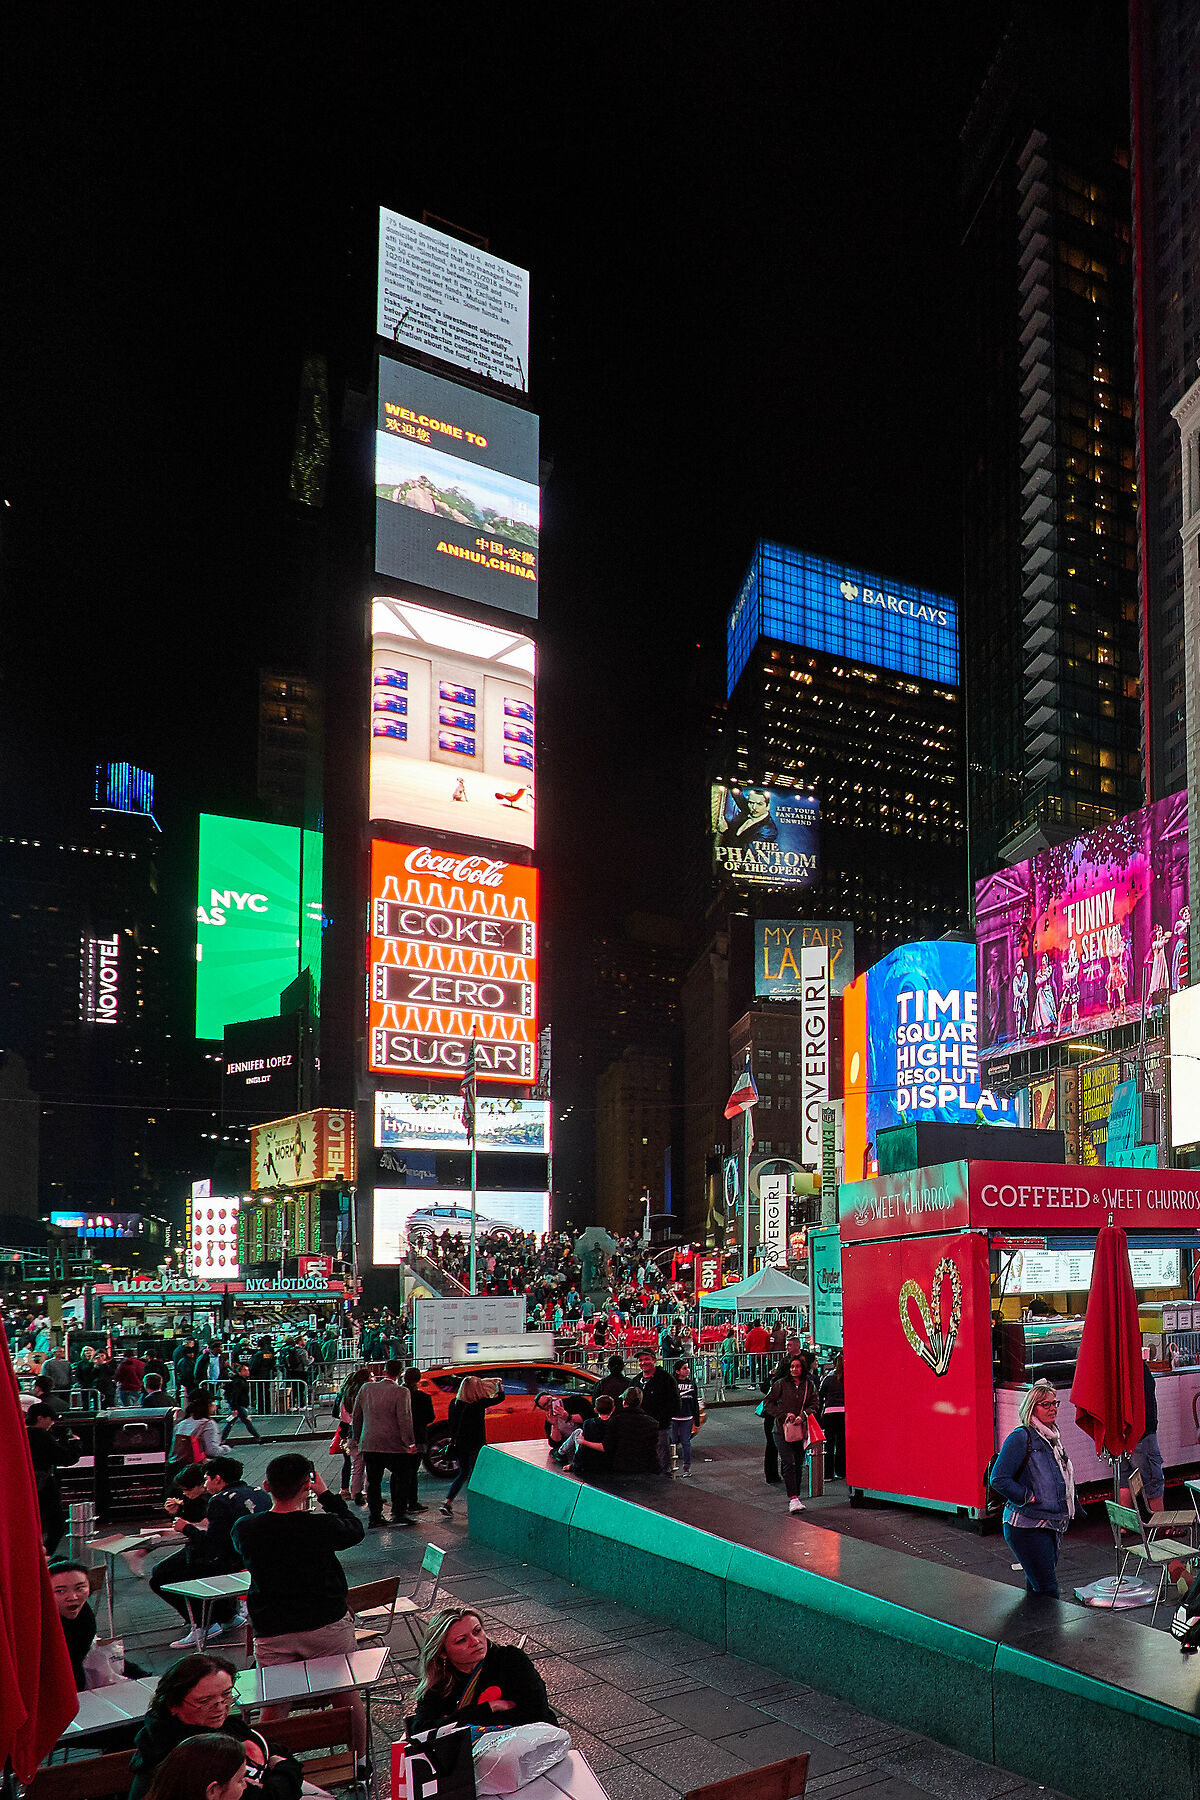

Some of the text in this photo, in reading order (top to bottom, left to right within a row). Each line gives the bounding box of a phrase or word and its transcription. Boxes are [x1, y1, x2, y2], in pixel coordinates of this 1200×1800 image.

[385, 402, 488, 448] WELCOME TO
[385, 417, 431, 443] 欢迎您
[862, 589, 948, 626] BARCLAYS
[775, 812, 817, 821] FANTASIES
[780, 818, 812, 826] UNWIND
[794, 807, 816, 815] YOUR
[714, 847, 817, 869] PHANTOM
[753, 841, 779, 851] THE
[404, 847, 508, 887] Coca-Cola
[724, 862, 809, 877] OF THE OPERA
[210, 888, 269, 913] NYC
[764, 927, 843, 948] MY FAIR
[764, 947, 844, 980] LAY
[96, 934, 119, 1023] NOVOTEL
[408, 973, 505, 1008] ZERO
[226, 1055, 293, 1075] JENNIFER LOPEZ
[389, 1036, 517, 1071] SUGAR
[805, 966, 826, 1146] COVERGIRL
[327, 1113, 345, 1178] HELLO!
[822, 1130, 836, 1197] EXPERIENCE
[870, 1184, 951, 1221] SWEET CHURROS
[981, 1184, 1200, 1210] COFFEED & SWEET CHURROS
[113, 1274, 329, 1293] nuchas NYC HOTDOGS
[701, 1260, 718, 1289] tkts
